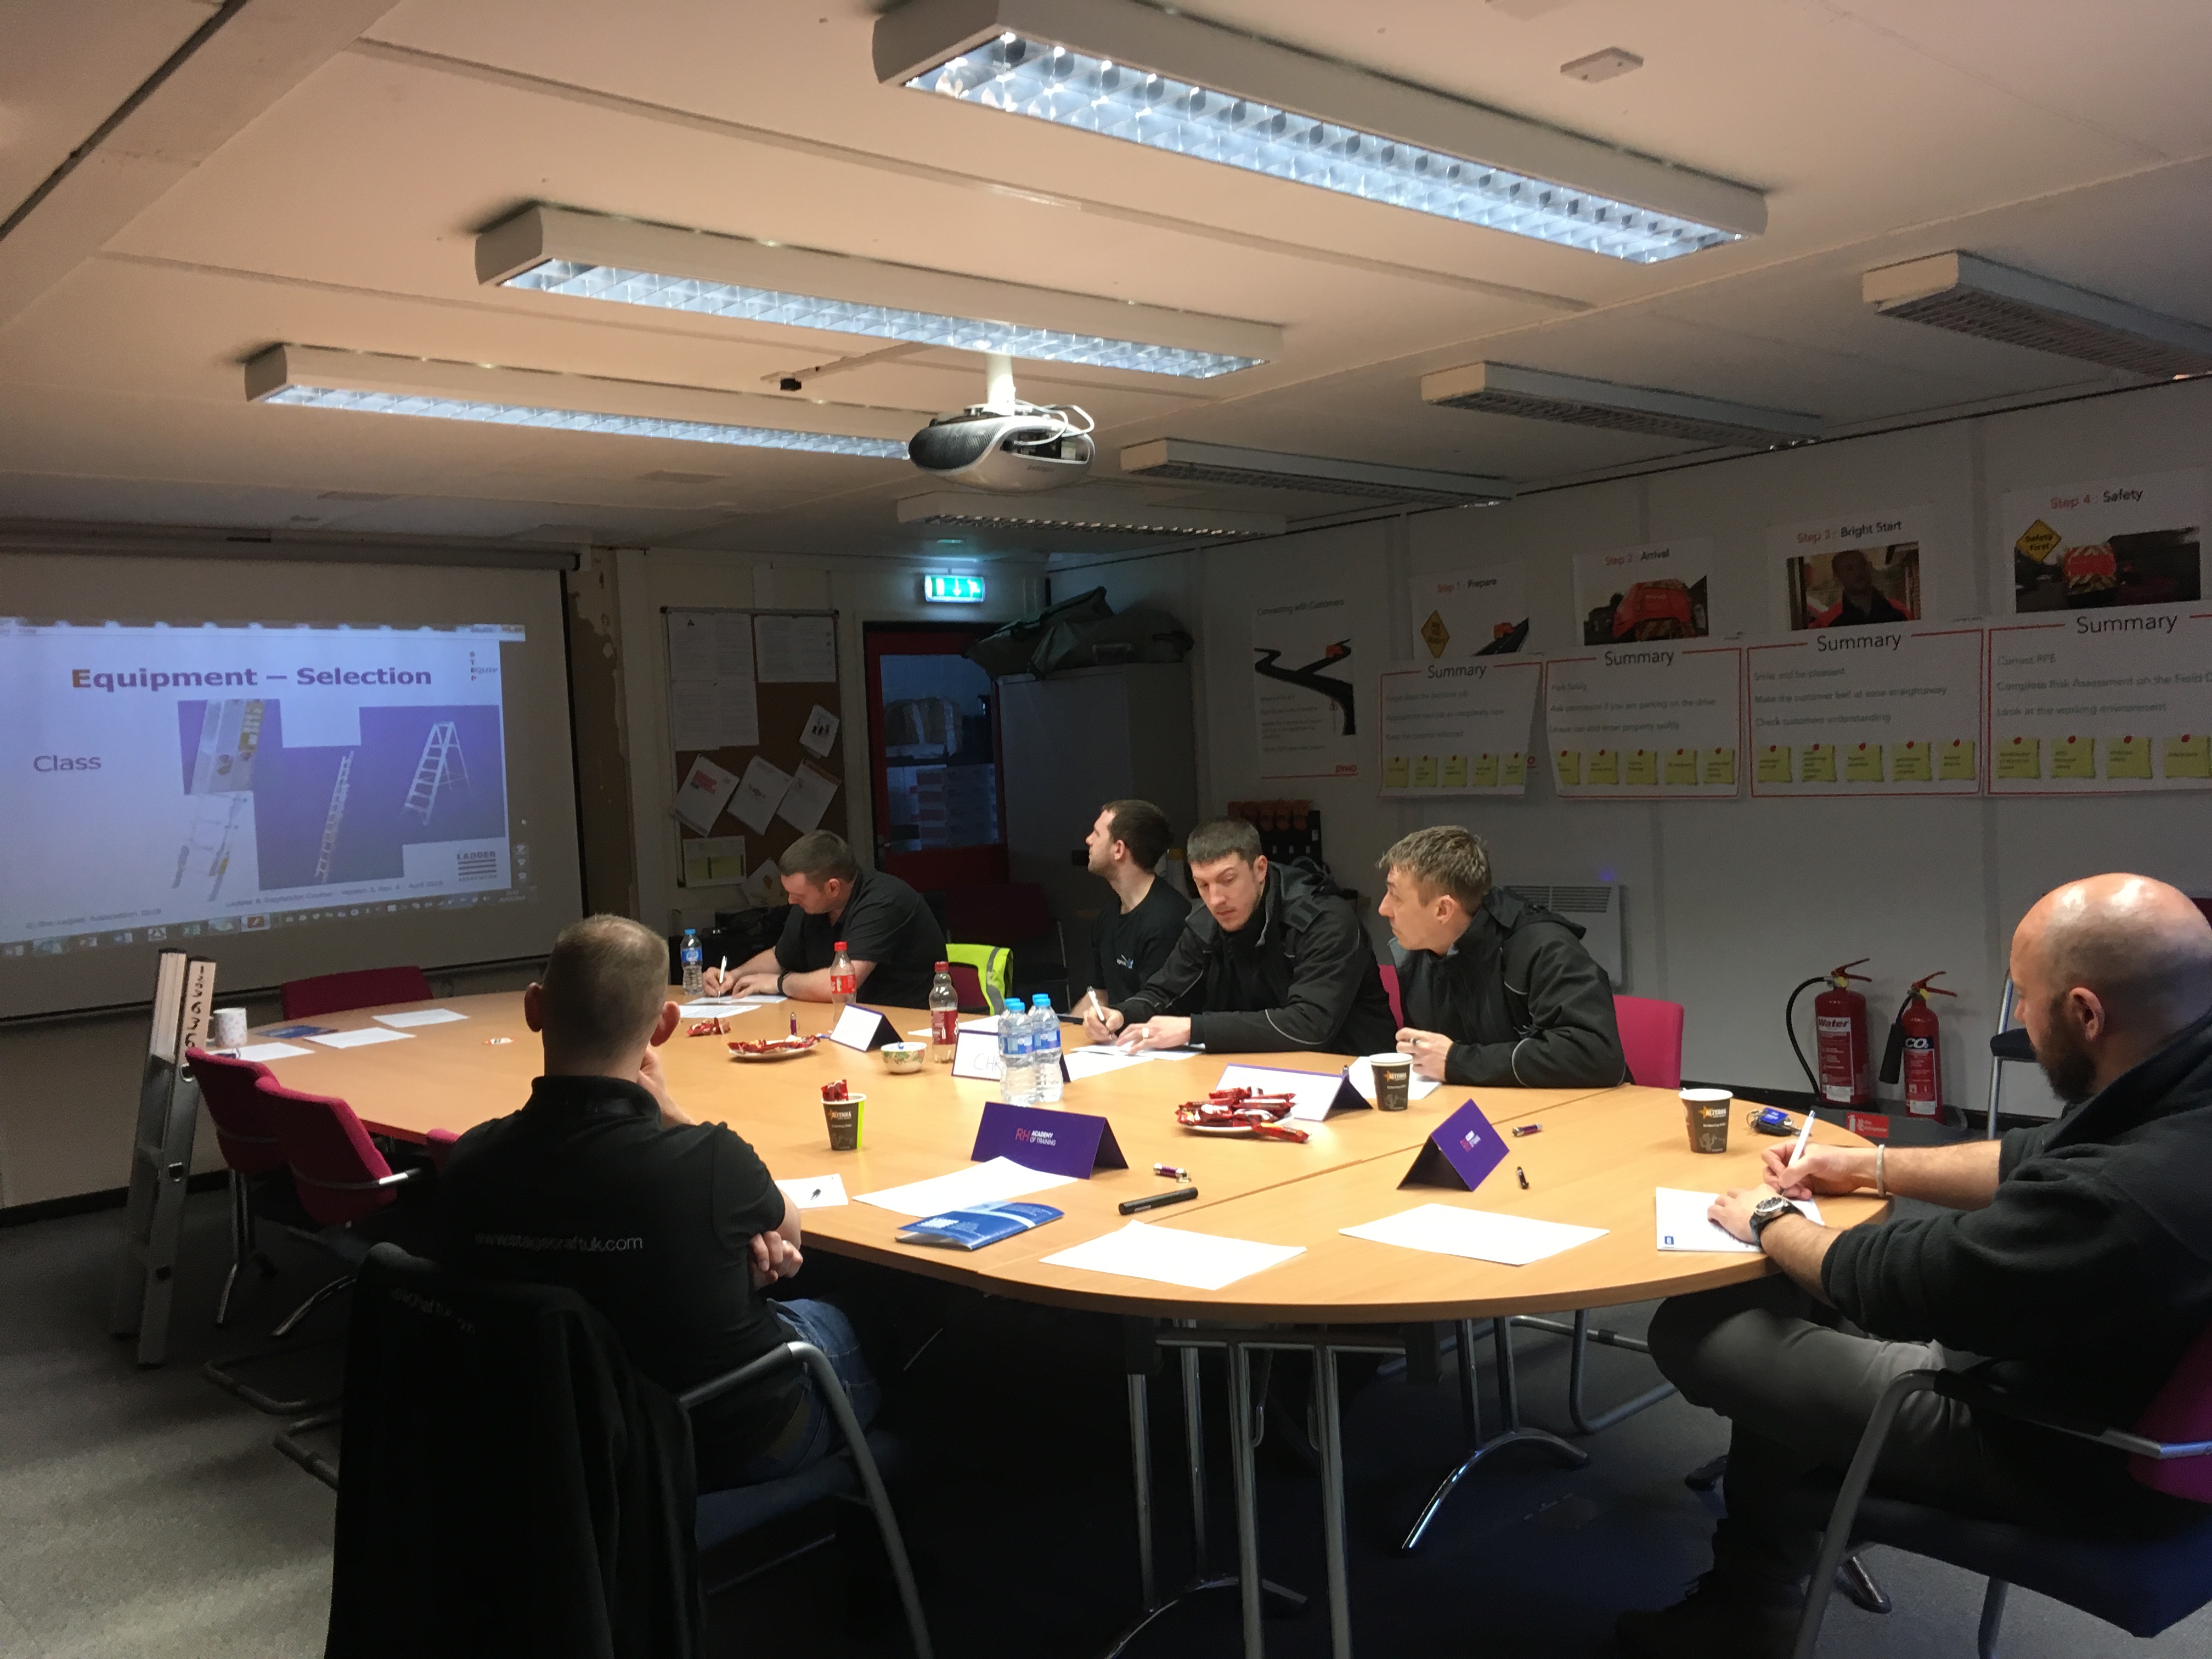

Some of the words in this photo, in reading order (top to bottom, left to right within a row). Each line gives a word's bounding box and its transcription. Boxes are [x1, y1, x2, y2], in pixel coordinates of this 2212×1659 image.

[2050, 497, 2079, 509] Step
[2103, 488, 2143, 504] Safety
[1797, 532, 1821, 544] Step
[1841, 524, 1873, 539] Bright
[1876, 521, 1902, 533] Start
[1605, 556, 1624, 566] Step
[1640, 549, 1670, 561] Arrival
[1468, 578, 1497, 589] Prepare
[1257, 605, 1294, 616] Connecting
[1310, 599, 1345, 610] Customers
[2076, 614, 2179, 634] Summary
[1817, 634, 1901, 652] Summary
[1605, 650, 1674, 667] Summary
[71, 668, 258, 692] Equipment
[296, 667, 431, 686] Selection
[1427, 663, 1487, 679] Summary
[33, 754, 102, 774] Class
[457, 851, 495, 860] LADDER
[1818, 1018, 1849, 1028] Water
[1015, 1128, 1031, 1142] RH
[1031, 1130, 1053, 1139] ACADEMY
[1036, 1137, 1056, 1147] TRAINING
